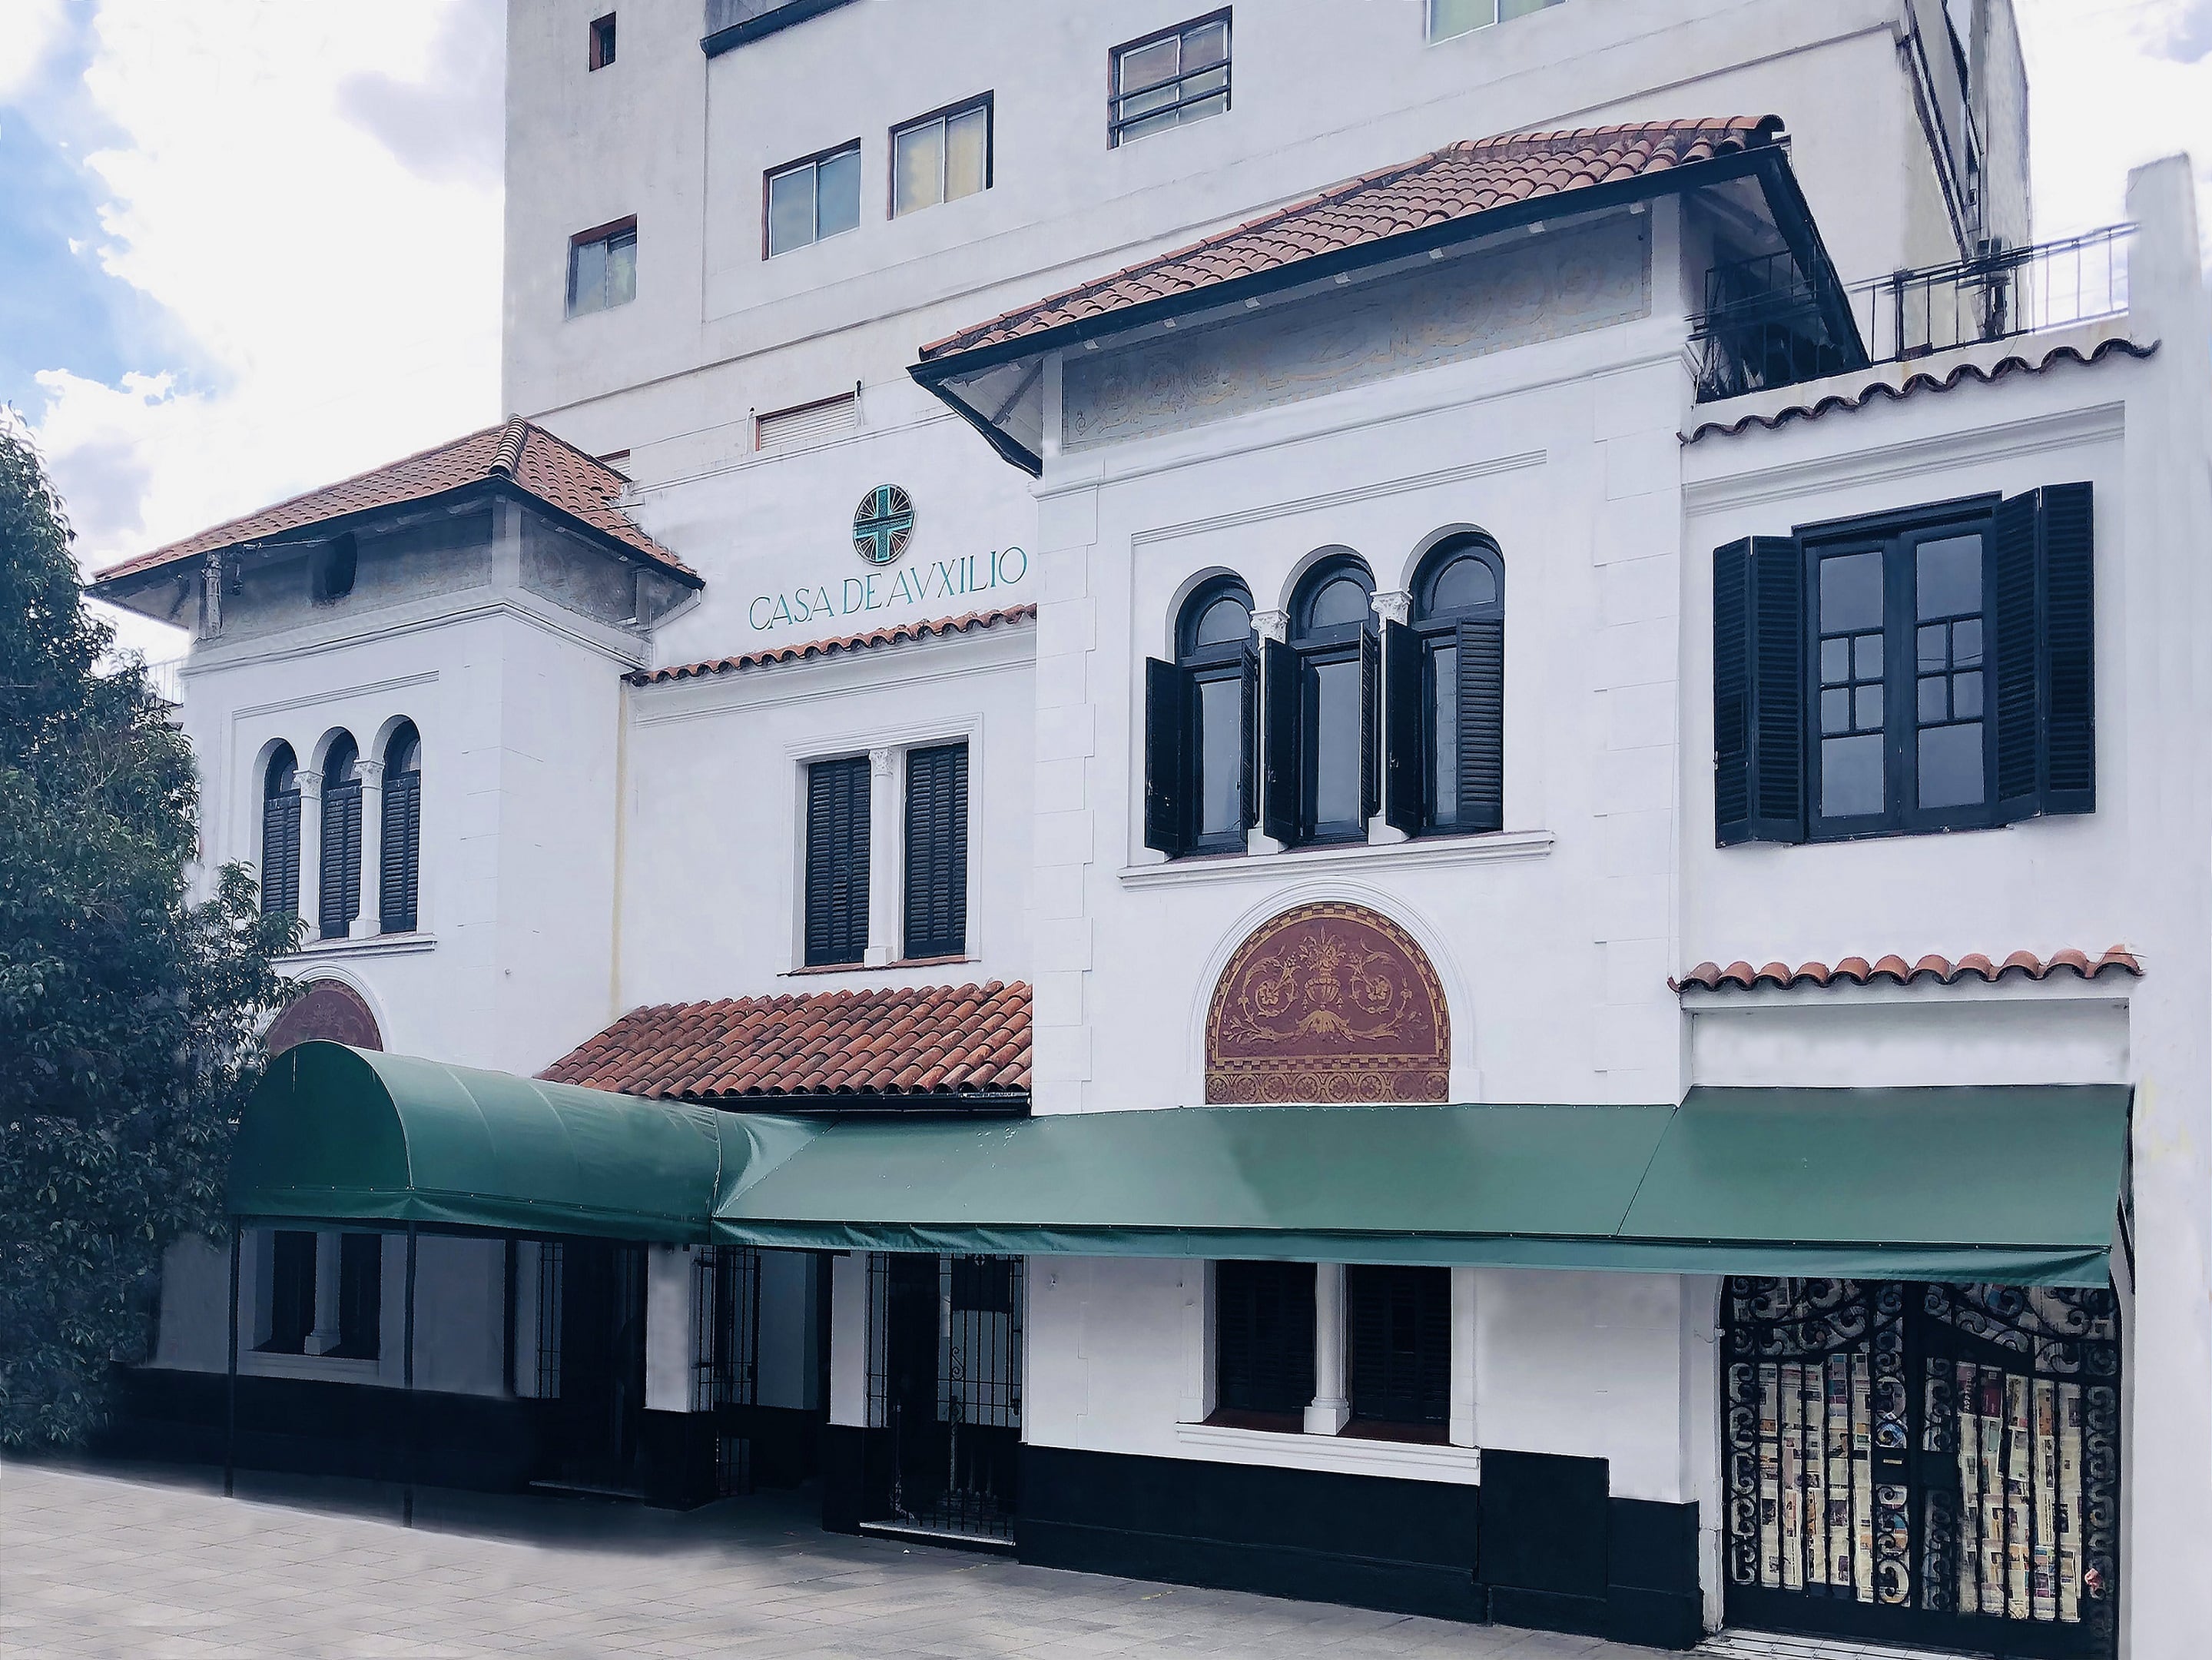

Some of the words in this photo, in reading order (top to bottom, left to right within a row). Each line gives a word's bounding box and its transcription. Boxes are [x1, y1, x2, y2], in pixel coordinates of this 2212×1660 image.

[749, 586, 835, 631] CASA
[842, 573, 884, 615] DE
[886, 546, 1028, 608] AVXILIO
